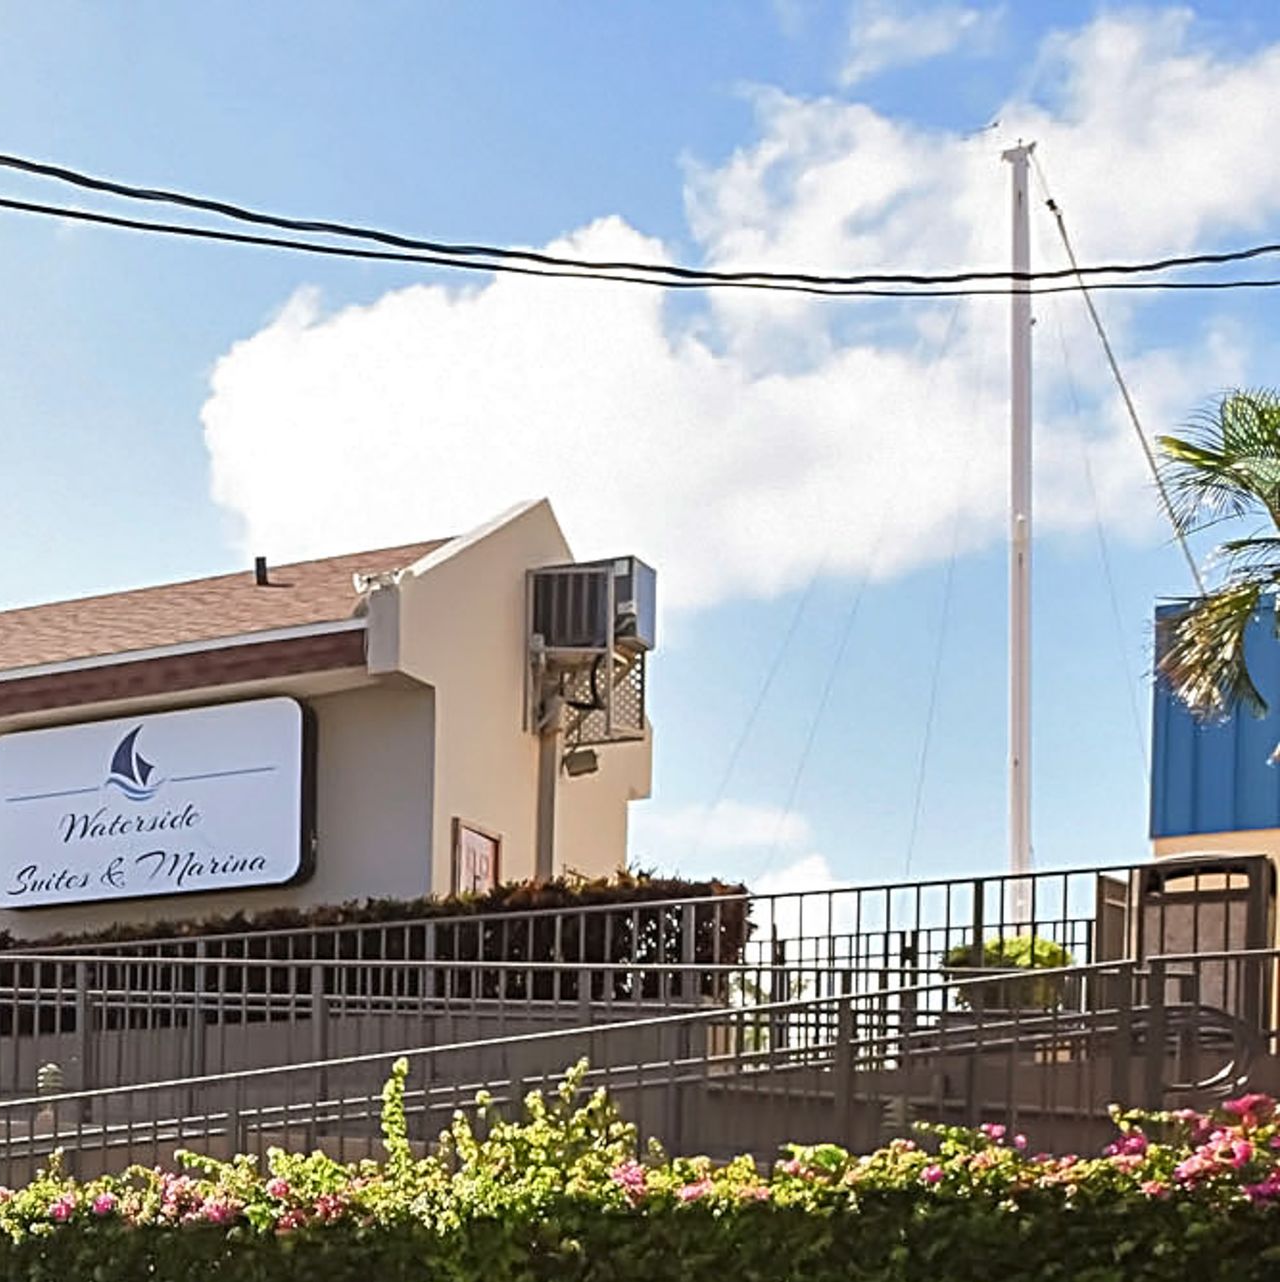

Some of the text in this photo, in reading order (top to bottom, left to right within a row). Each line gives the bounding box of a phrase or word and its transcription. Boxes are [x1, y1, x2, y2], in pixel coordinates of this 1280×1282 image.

[59, 803, 201, 844] Waterside
[7, 850, 267, 896] Suites & Marina
